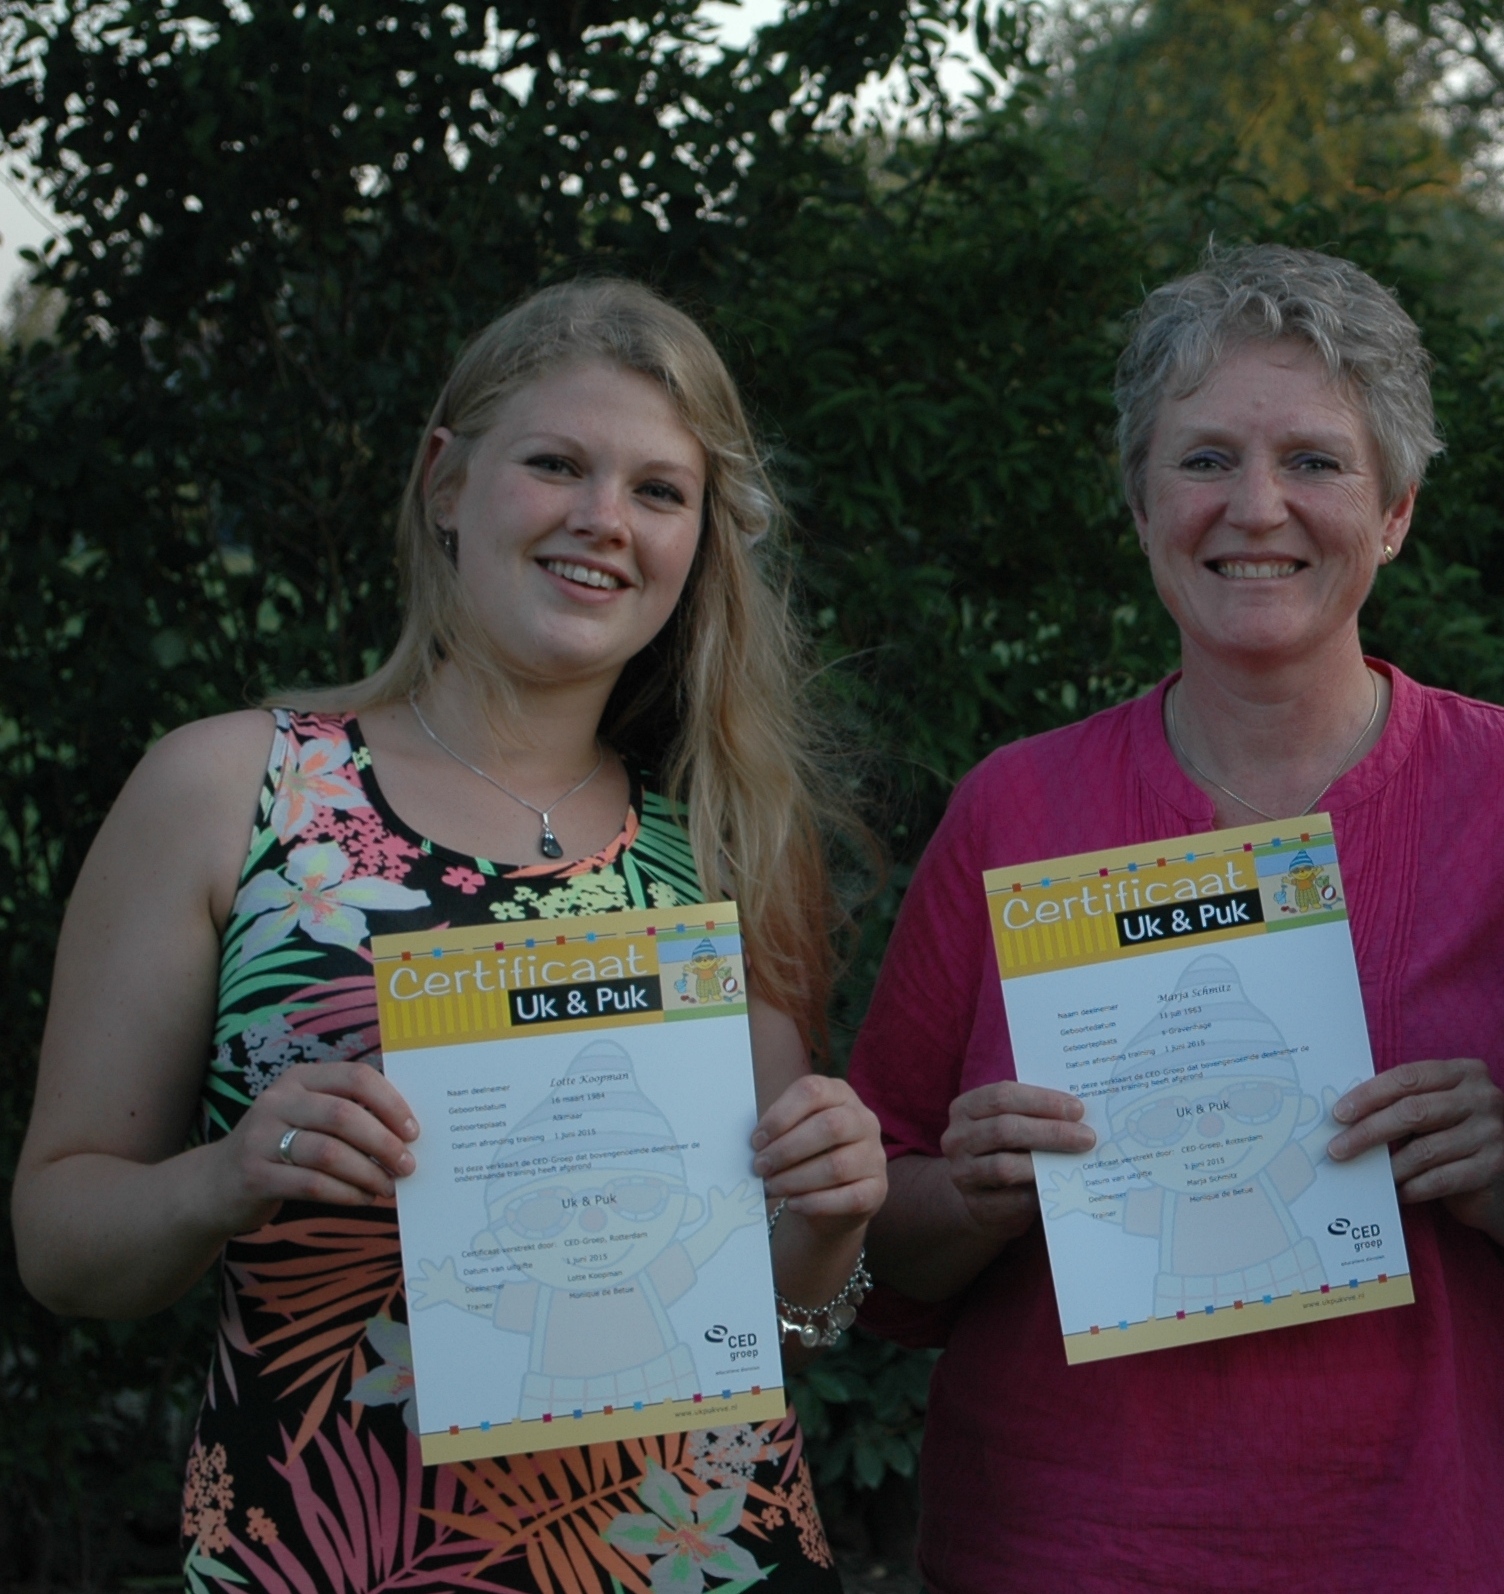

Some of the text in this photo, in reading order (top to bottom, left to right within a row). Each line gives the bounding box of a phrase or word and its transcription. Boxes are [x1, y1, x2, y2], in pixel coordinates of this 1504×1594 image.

[1001, 860, 1248, 930] Certificaat
[1122, 897, 1250, 941] Uk & Puk
[388, 944, 649, 1001] Certificaat
[516, 983, 648, 1020] Uk & Puk
[1155, 983, 1231, 1003] Marja Schmitz
[1186, 1039, 1205, 1048] 2015
[548, 1072, 629, 1087] Lotte Koopman
[1175, 1099, 1230, 1118] Uk & Puk
[577, 1128, 596, 1137] 2015
[1206, 1156, 1225, 1166] 2015
[561, 1192, 616, 1209] Uk & Puk
[1350, 1223, 1381, 1240] CED
[1353, 1238, 1383, 1252] groep
[589, 1252, 607, 1262] 2015
[727, 1332, 757, 1349] CED
[729, 1348, 759, 1361] groep
